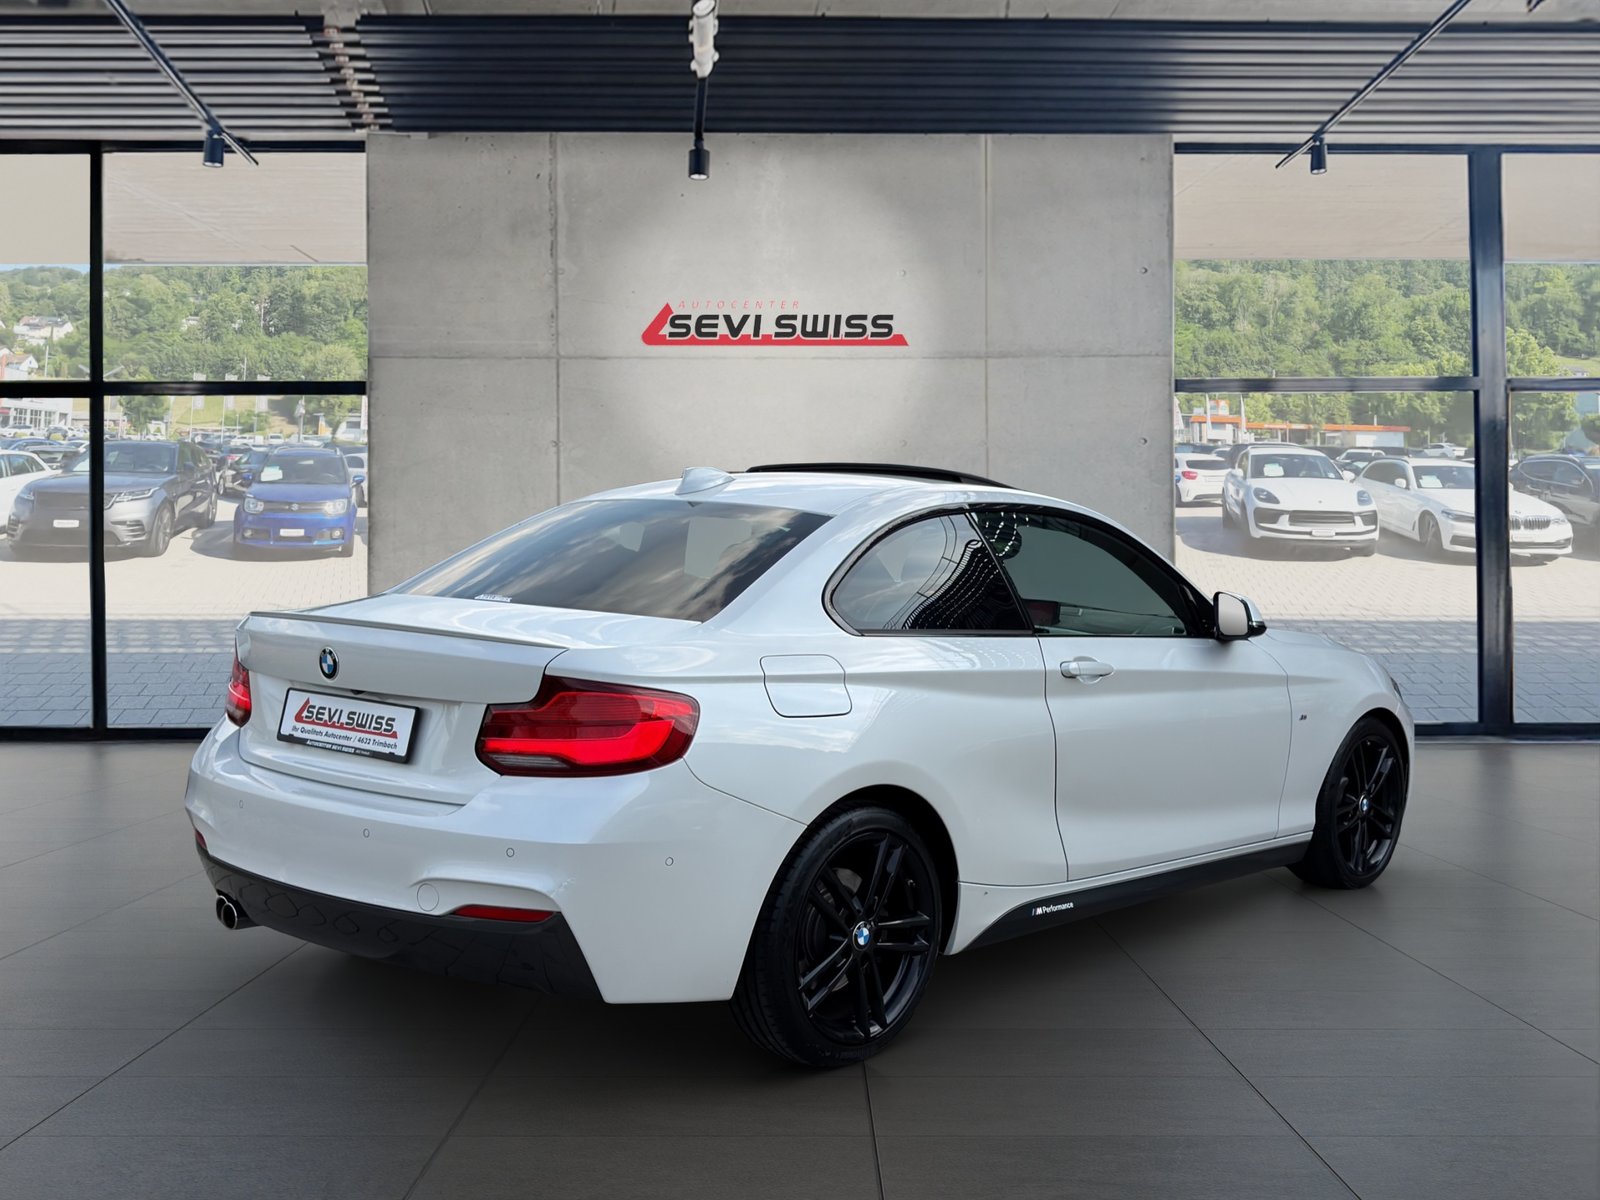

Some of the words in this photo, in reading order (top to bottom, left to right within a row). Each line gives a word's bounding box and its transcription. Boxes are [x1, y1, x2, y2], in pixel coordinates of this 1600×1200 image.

[678, 300, 800, 310] AUTOCENTER
[668, 314, 762, 338] SEVI
[773, 314, 894, 338] SWISS
[304, 704, 343, 724] SEVI
[345, 711, 396, 733] SWISS
[324, 731, 353, 742] Autocenter
[372, 739, 398, 750] Trimbach
[1042, 902, 1074, 914] Performance
